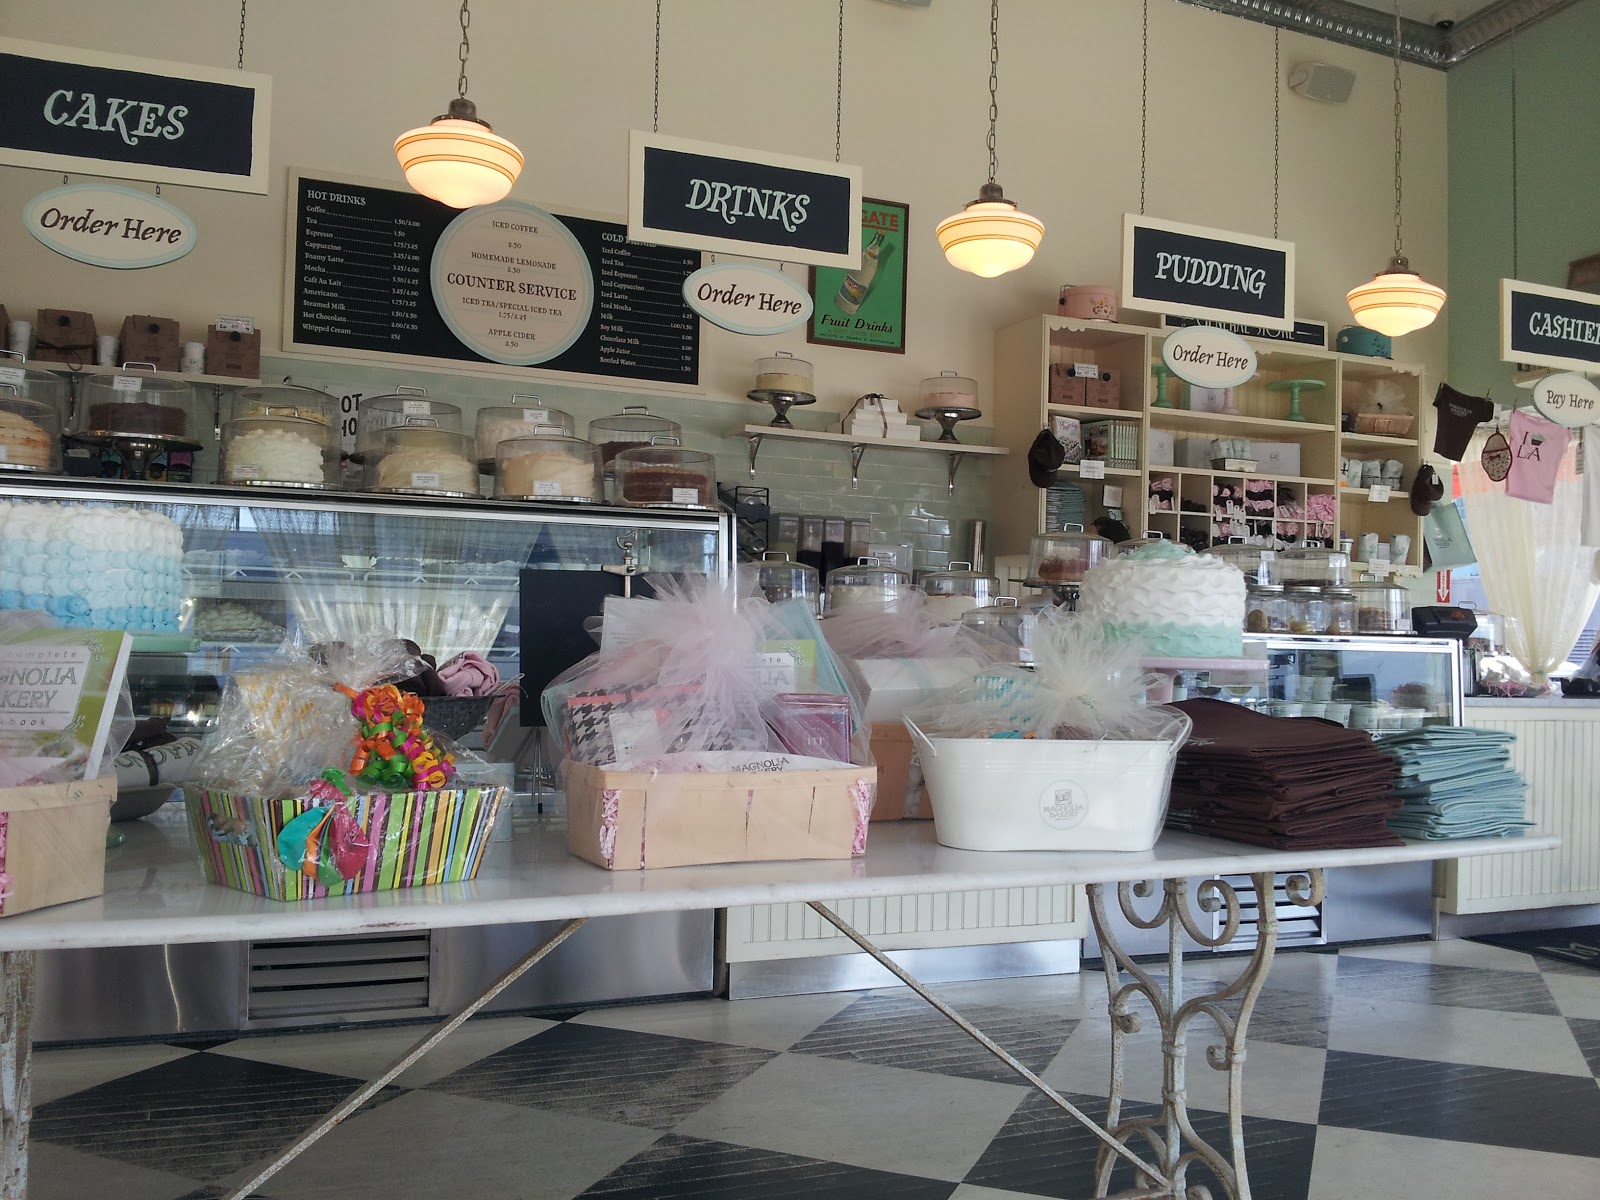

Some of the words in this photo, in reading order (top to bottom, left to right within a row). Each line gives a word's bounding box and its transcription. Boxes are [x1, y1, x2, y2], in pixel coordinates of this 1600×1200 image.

[44, 89, 188, 146] CAKES
[307, 189, 327, 200] HOT
[329, 192, 366, 206] DRINKS
[306, 205, 326, 214] Coffee
[685, 178, 810, 232] DRINKS
[40, 207, 119, 233] Order
[122, 218, 182, 244] Here
[306, 217, 318, 225] Tea
[492, 221, 510, 229] ICED
[511, 223, 538, 233] COFFEE
[305, 229, 333, 239] Espresso
[602, 233, 624, 243] COLD
[305, 241, 342, 251] Cappuccino
[602, 247, 614, 255] Iced
[305, 253, 326, 262] Foamy
[328, 255, 344, 263] Latte
[471, 252, 515, 264] HOMEMADE
[516, 258, 557, 270] LEMONADE
[304, 264, 326, 273] Mocha
[614, 271, 637, 280] Espresso
[1155, 252, 1266, 299] PUDDING
[447, 272, 516, 293] COUNTER
[519, 282, 577, 301] SERVICE
[614, 282, 645, 291] Cappuccino
[303, 288, 338, 298] Americano
[614, 292, 628, 300] Latte
[697, 283, 756, 308] Order
[758, 292, 802, 315] Here
[303, 300, 330, 308] Steamed
[331, 303, 346, 311] Milk
[462, 297, 480, 306] ICED
[482, 300, 529, 312] TEA/SPECIAL
[531, 306, 548, 314] ICED
[549, 308, 562, 316] TEA
[613, 304, 632, 312] Mocha
[316, 312, 347, 322] Chocolate
[600, 324, 610, 332] Soy
[821, 314, 851, 328] Fruit
[854, 318, 894, 333] Drinks
[302, 323, 329, 333] Whipped
[330, 326, 351, 335] Cream
[488, 328, 512, 338] APPLE
[513, 331, 536, 340] CIDER
[600, 335, 626, 343] Chocolate
[627, 337, 640, 345] Milk
[600, 346, 615, 355] Apple
[600, 357, 619, 365] Bottled
[1173, 344, 1214, 365] Order
[1216, 351, 1249, 370] Here
[1546, 390, 1566, 409] Pay
[1569, 394, 1595, 411] Here
[1522, 431, 1529, 446] I
[1516, 444, 1541, 462] LA
[8, 651, 77, 659] omplete
[0, 690, 58, 708] KERY
[732, 757, 790, 773] MAGNOLIA
[1043, 804, 1084, 813] MAGNOLIA
